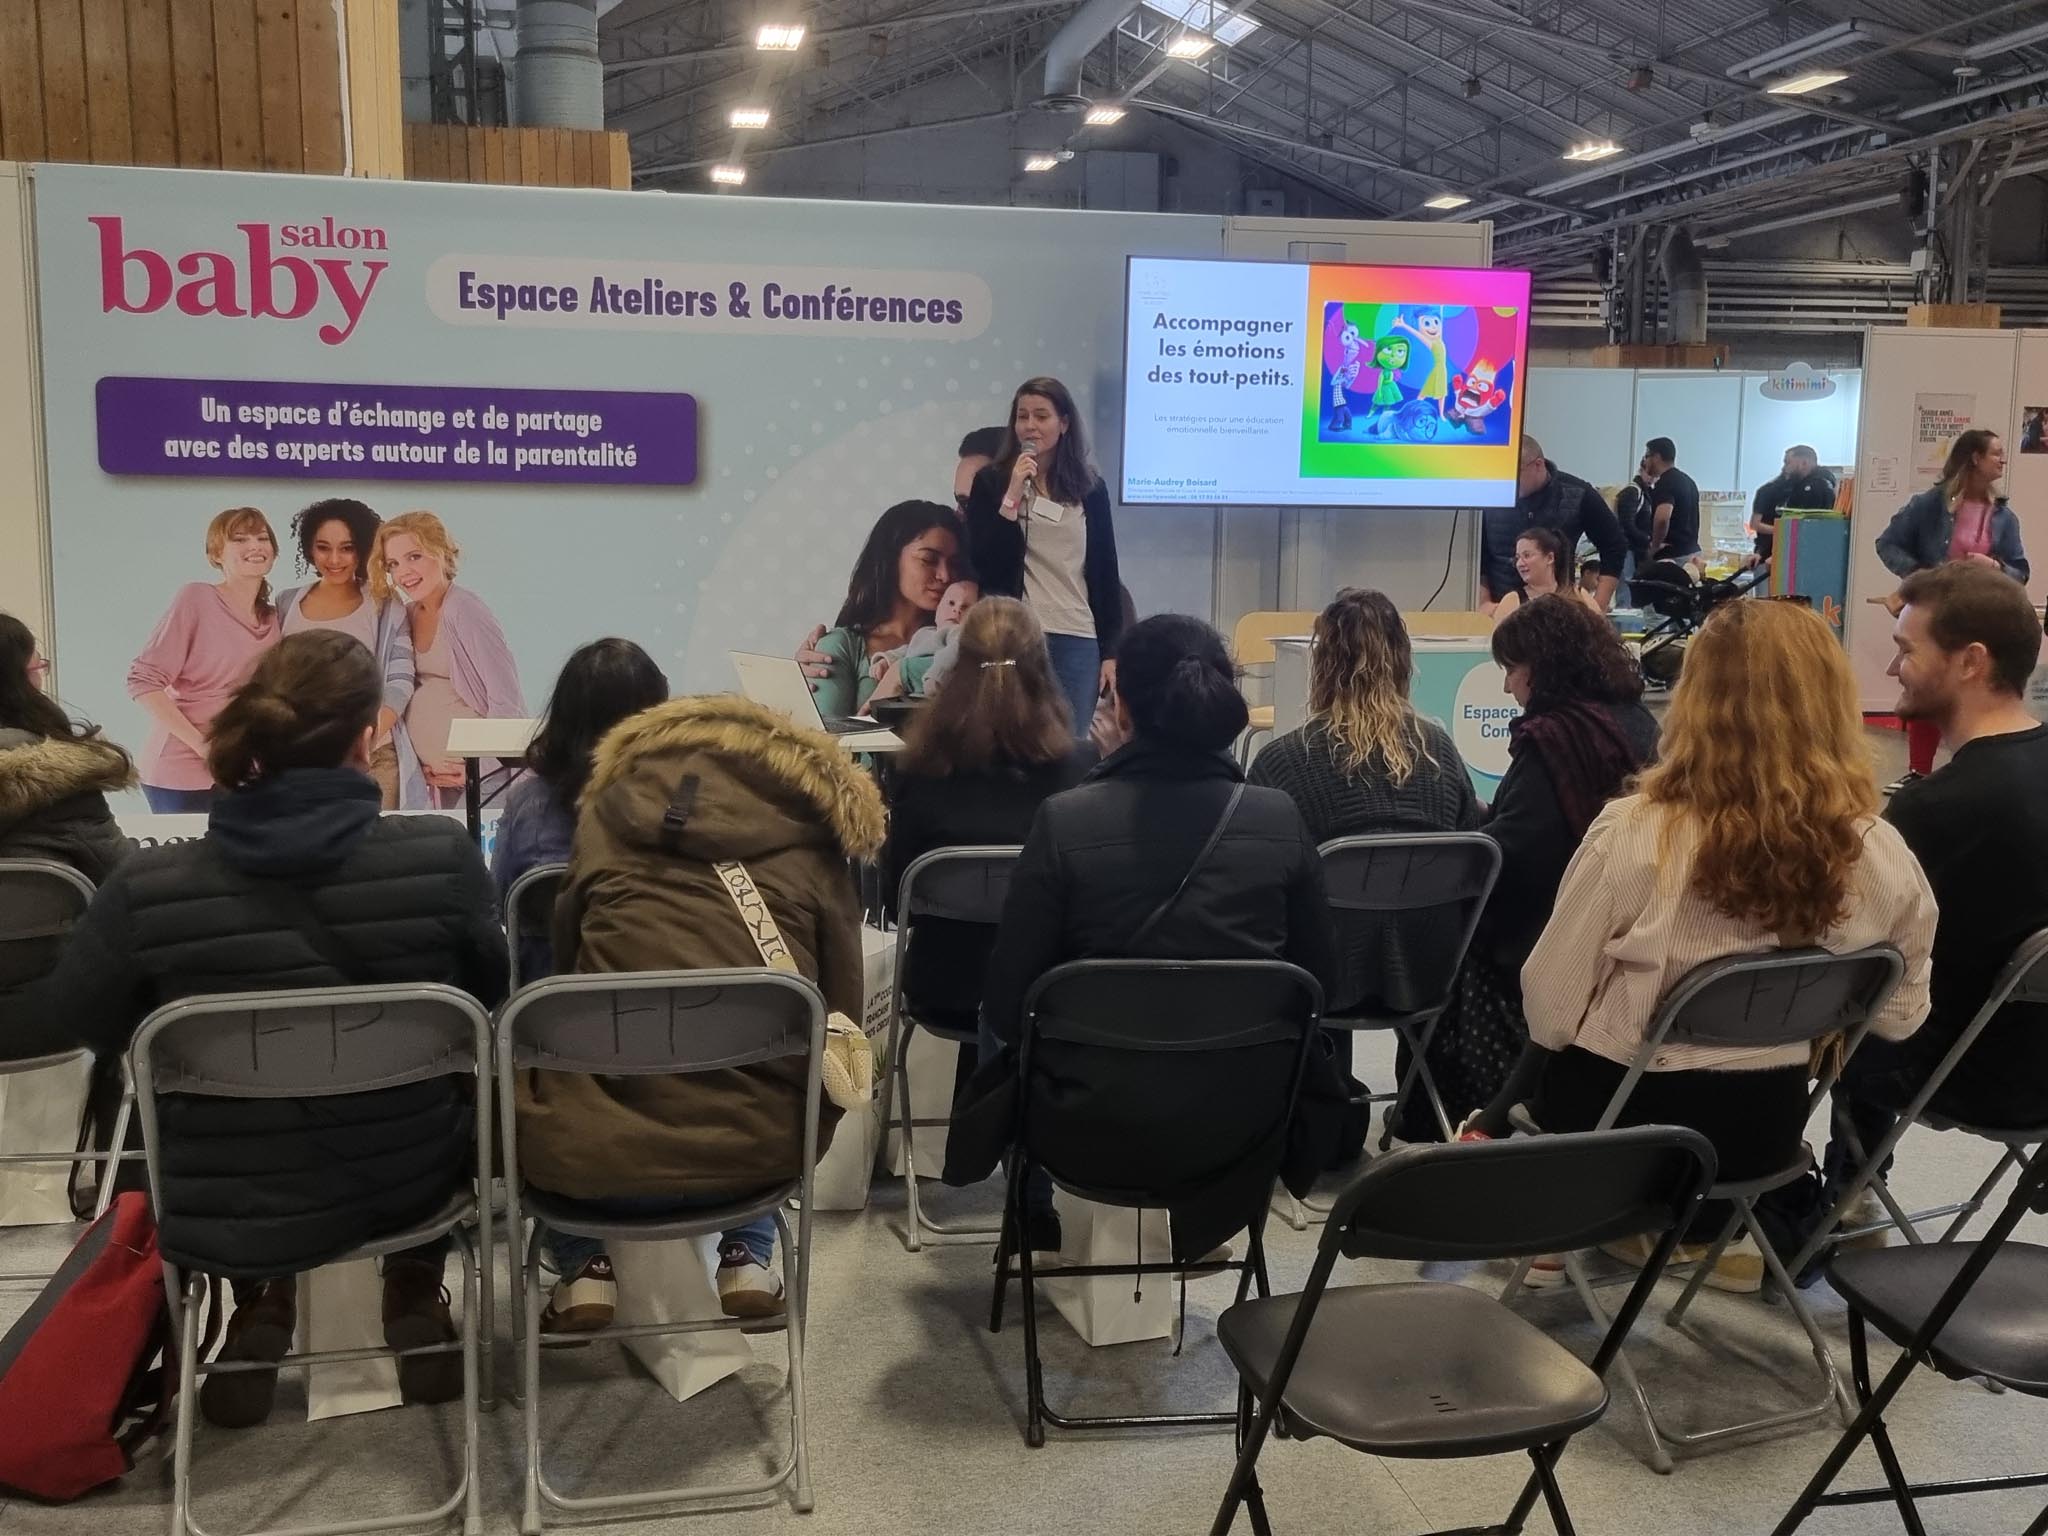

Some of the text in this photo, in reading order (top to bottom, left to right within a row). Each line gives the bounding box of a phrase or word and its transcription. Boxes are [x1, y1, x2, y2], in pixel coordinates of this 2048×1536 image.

[280, 217, 389, 251] salon
[89, 217, 389, 345] baby
[458, 271, 963, 325] Espace Ateliers & Conférences
[1153, 312, 1294, 337] Accompagner
[1159, 338, 1285, 360] les émotions
[1147, 364, 1294, 390] des tout-petits.
[1771, 377, 1827, 391] kitimimi
[201, 397, 603, 438] Un espace d’échange et de partage
[1154, 412, 1284, 425] Les stratégies pour une éducation
[1166, 425, 1218, 434] émotionnelle
[164, 434, 638, 472] avec des experts autour de la parentalité
[1127, 477, 1218, 488] Marie-Audrey Boisard
[1463, 704, 1519, 721] Espace
[1481, 723, 1510, 739] Con
